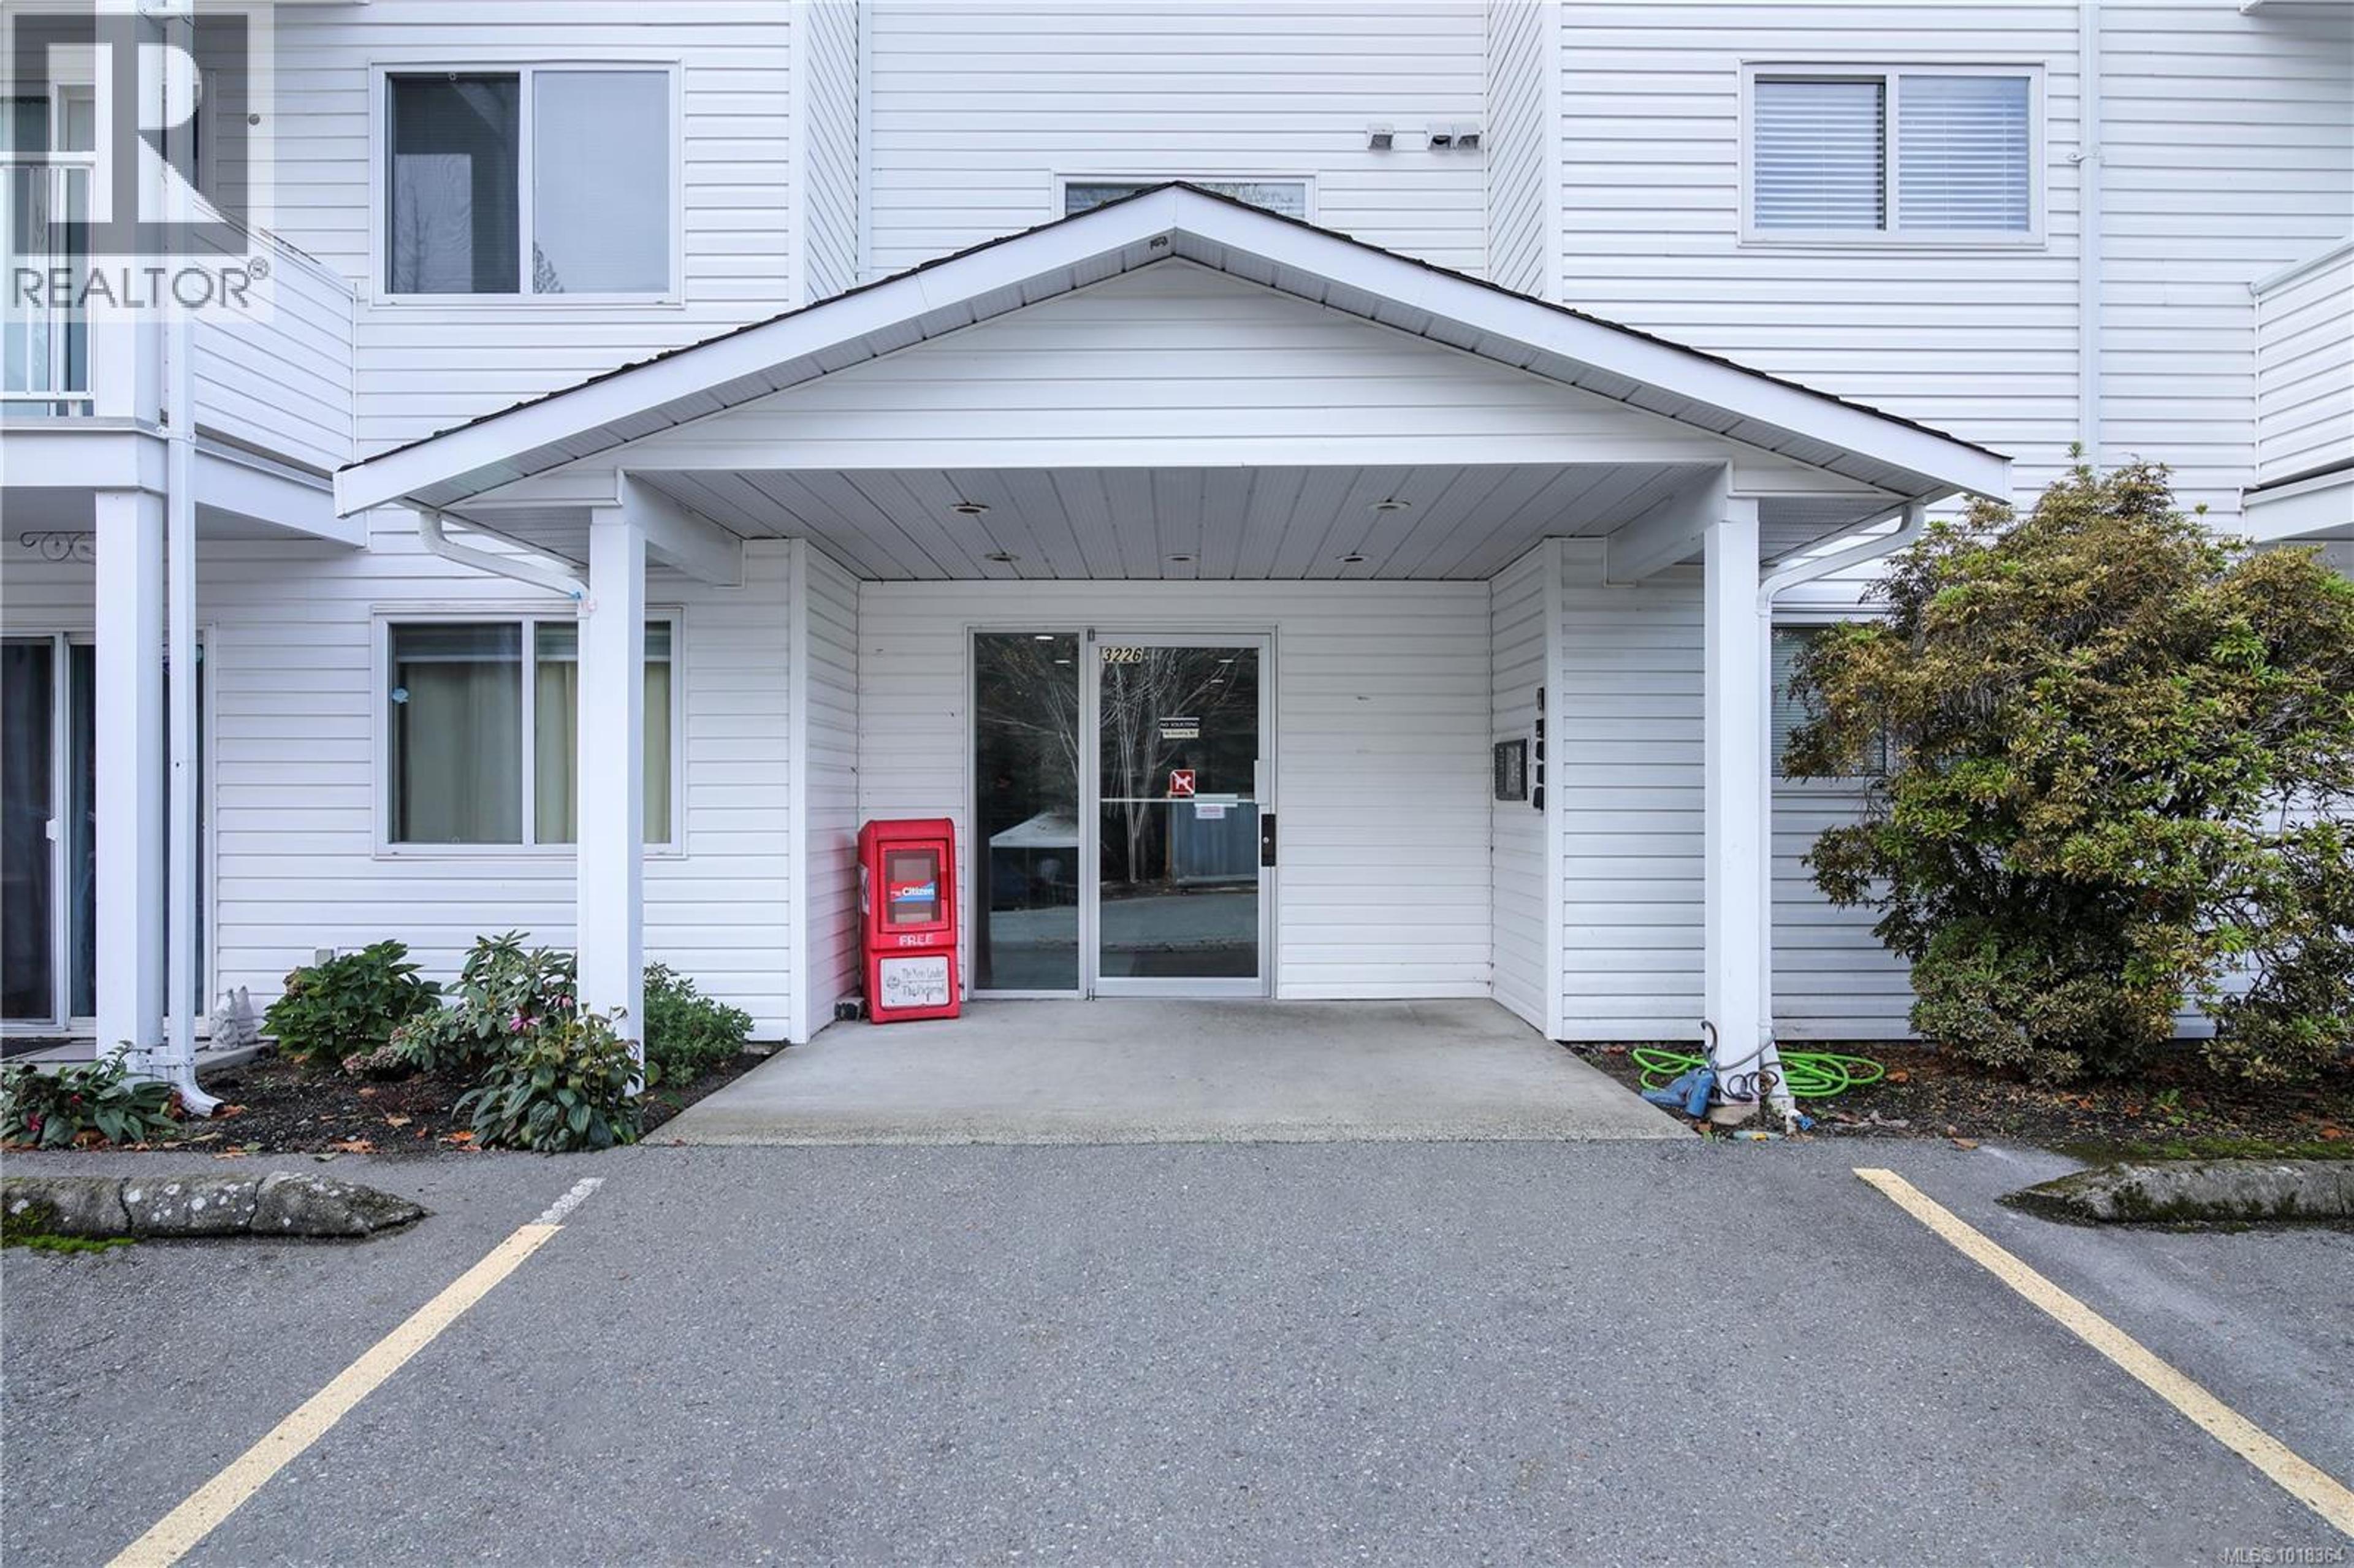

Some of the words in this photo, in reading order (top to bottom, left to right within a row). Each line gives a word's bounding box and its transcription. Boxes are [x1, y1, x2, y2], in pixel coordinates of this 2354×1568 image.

[1103, 647, 1142, 661] 3226
[902, 886, 935, 896] Citizen
[899, 933, 934, 946] FREE
